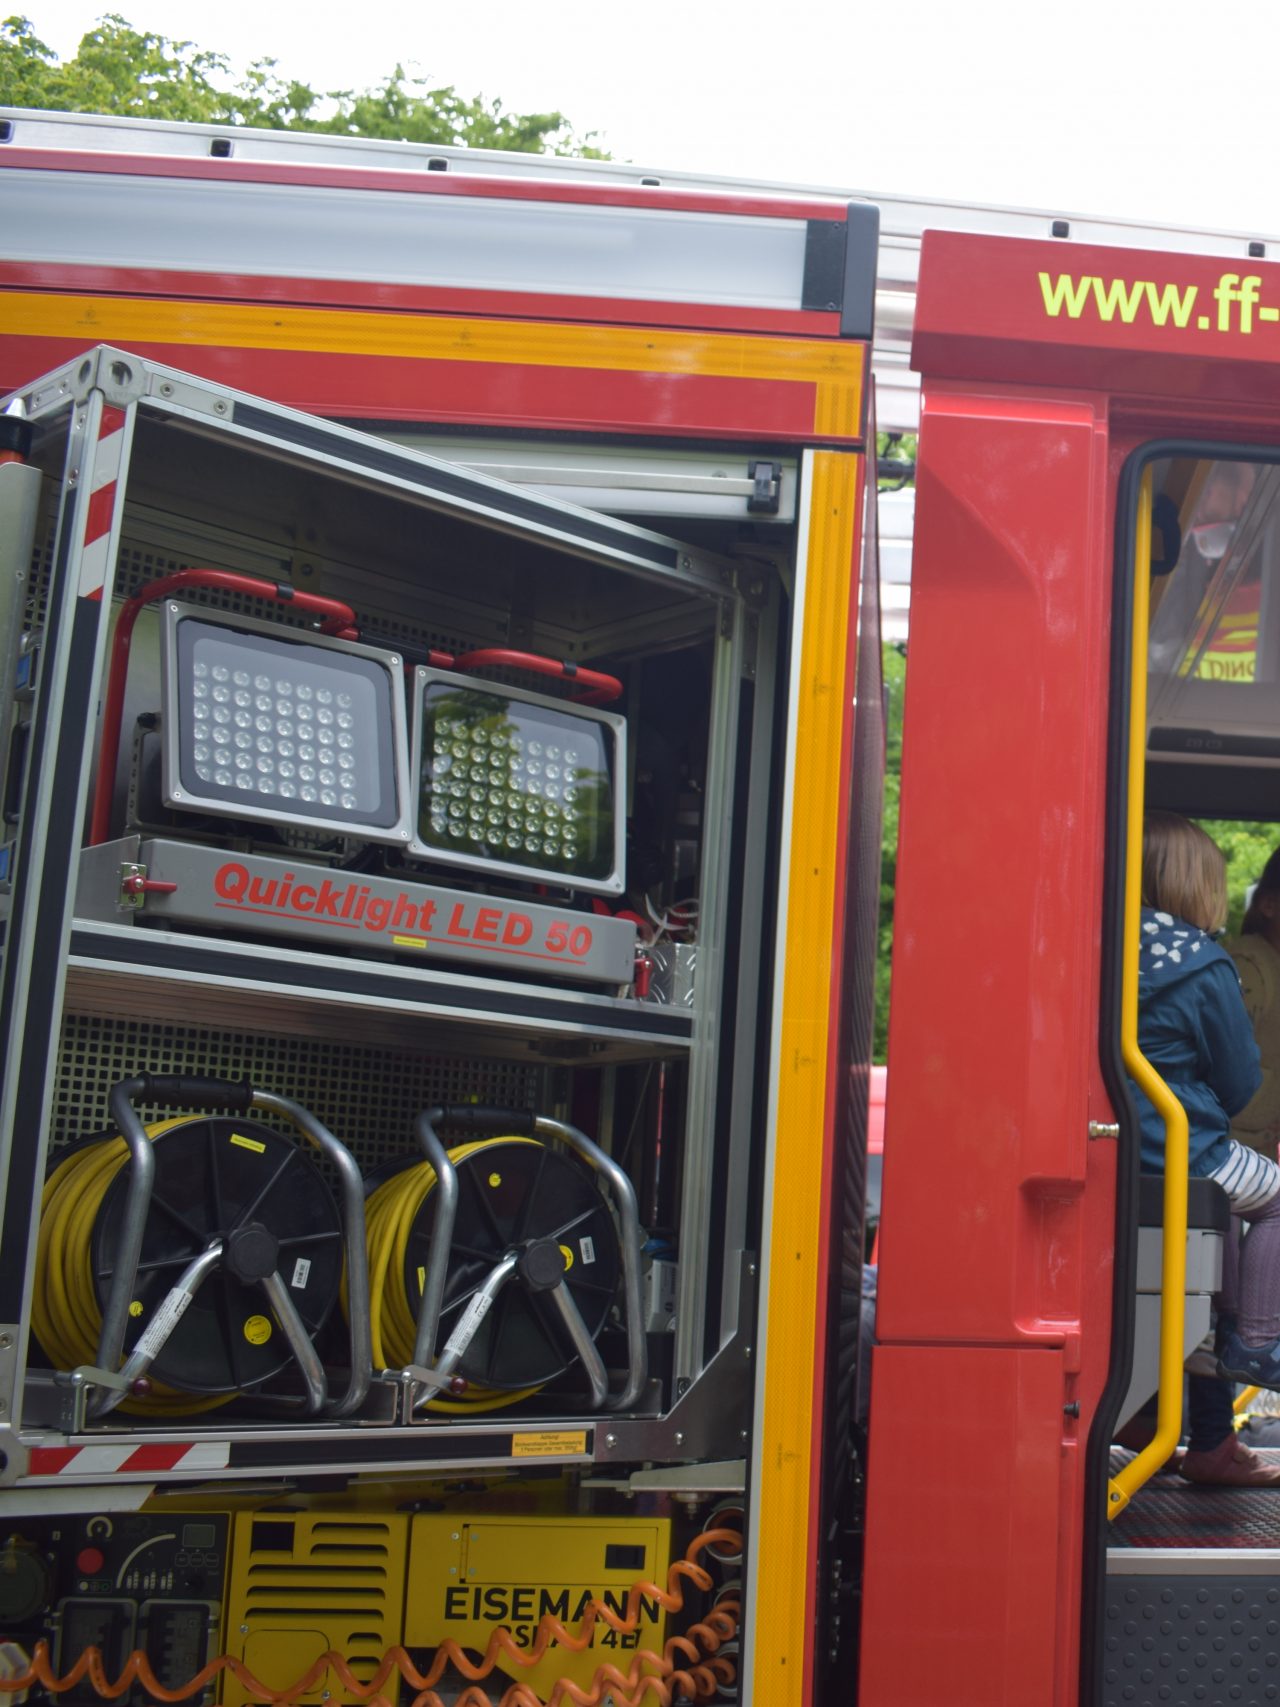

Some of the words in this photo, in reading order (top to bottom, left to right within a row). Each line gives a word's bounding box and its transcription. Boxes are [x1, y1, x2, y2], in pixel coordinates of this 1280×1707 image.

[214, 862, 437, 931] Quicklight
[447, 903, 533, 946] LED
[544, 920, 593, 956] 50
[444, 1586, 660, 1624] EISEMANN
